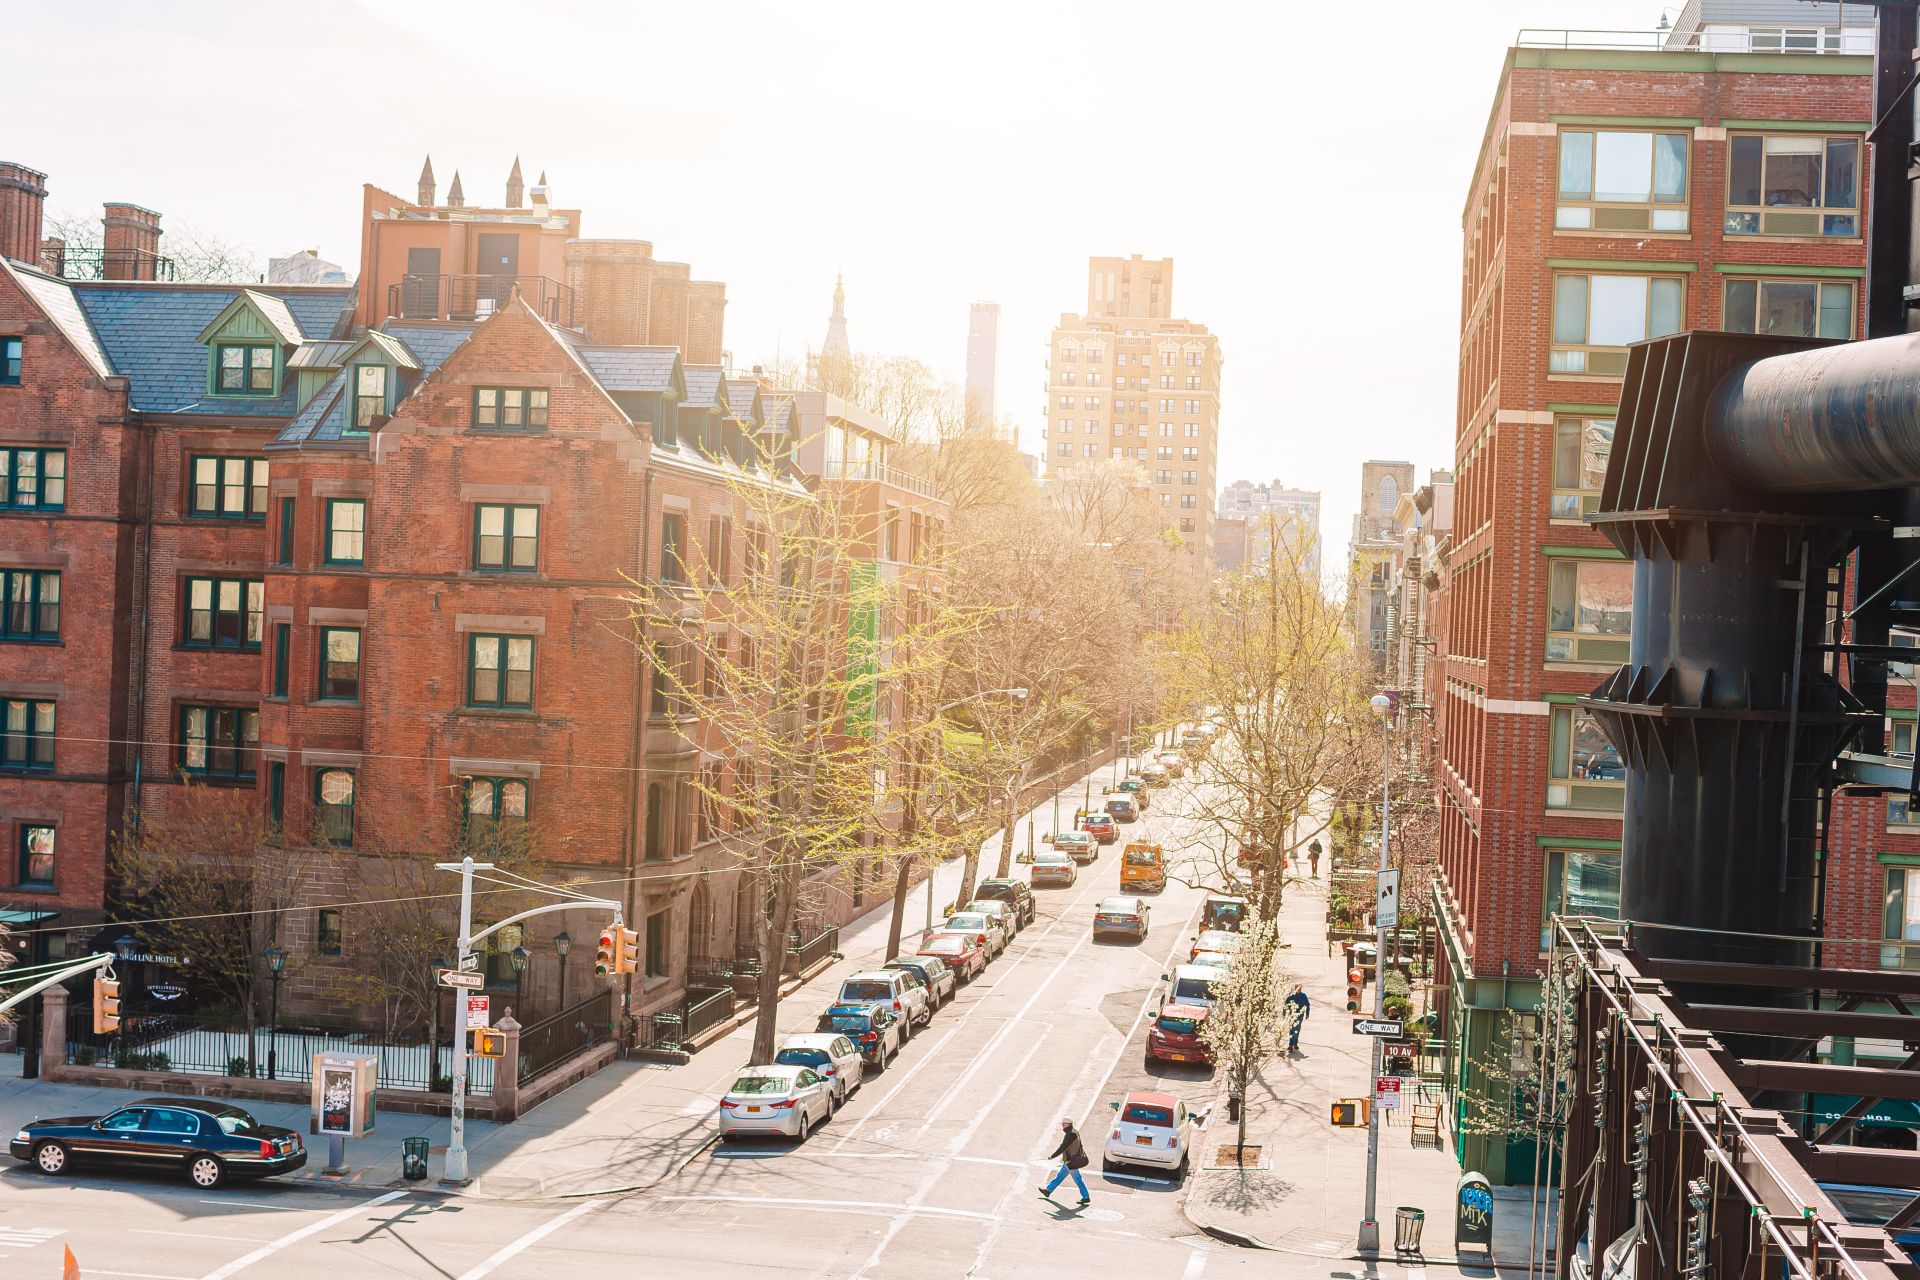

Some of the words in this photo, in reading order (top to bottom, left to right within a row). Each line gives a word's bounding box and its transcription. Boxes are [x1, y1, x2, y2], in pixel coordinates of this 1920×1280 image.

[155, 955, 177, 964] HOTEL
[446, 975, 458, 983] ONE
[465, 977, 478, 985] WAY
[1360, 1023, 1374, 1031] ONE
[1389, 1047, 1398, 1056] 10
[1401, 1048, 1412, 1056] Av
[1825, 1112, 1892, 1122] COHOP
